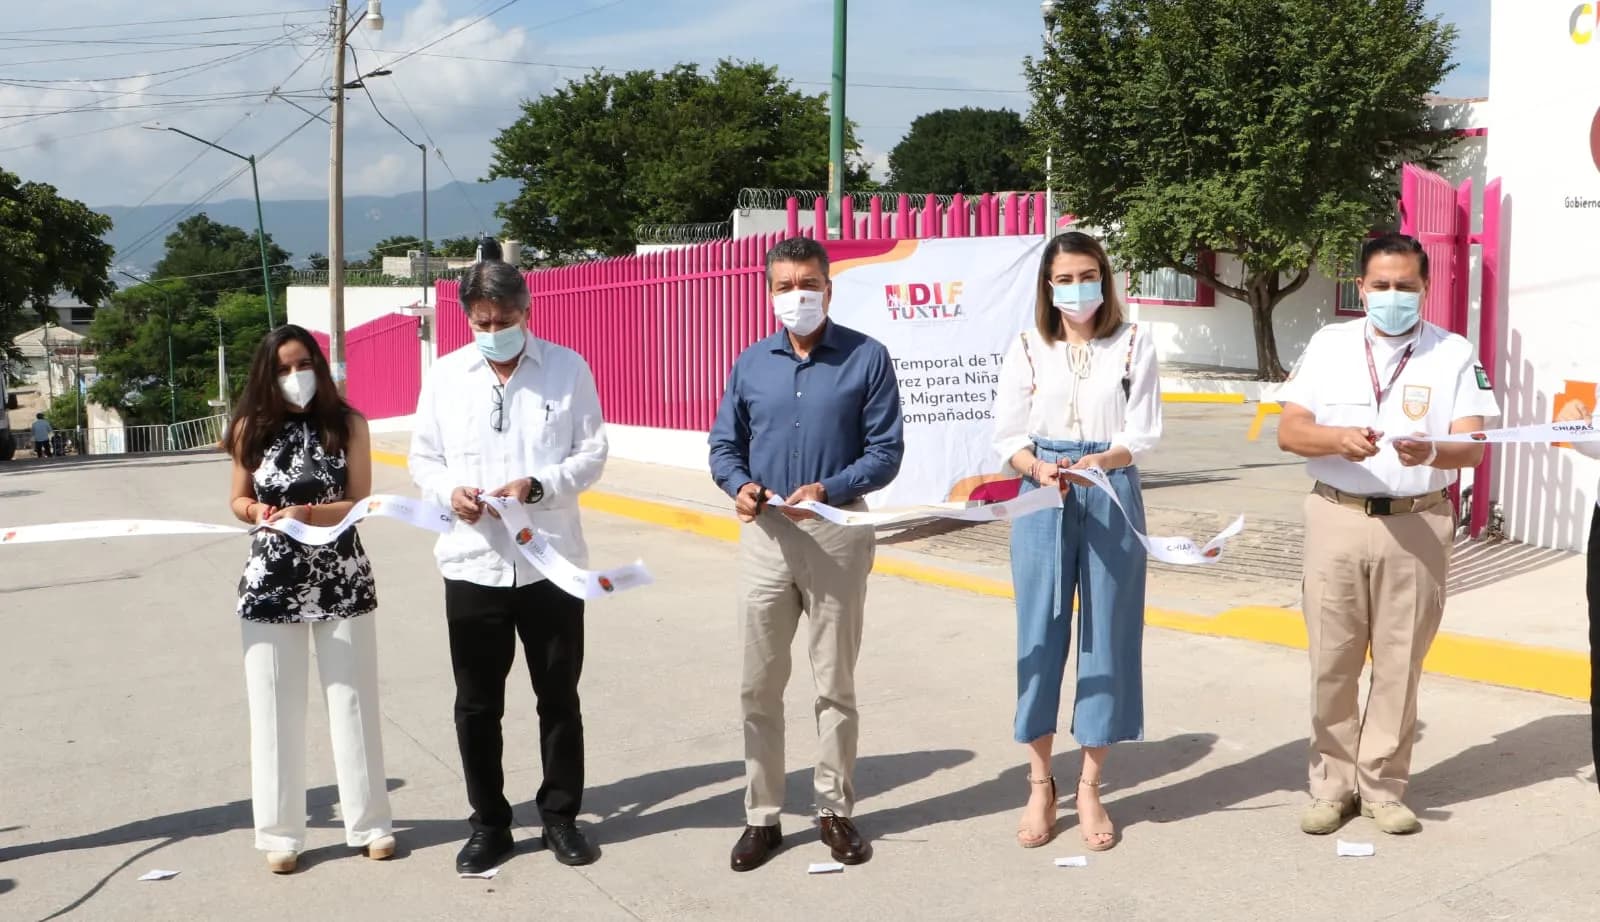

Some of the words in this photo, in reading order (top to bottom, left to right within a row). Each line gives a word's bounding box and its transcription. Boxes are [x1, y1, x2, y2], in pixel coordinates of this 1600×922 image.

[888, 304, 964, 320] TUXTLA
[891, 355, 964, 371] Temporal
[968, 354, 987, 367] de
[926, 375, 960, 389] para
[964, 371, 999, 385] Niña
[910, 391, 987, 407] Migrantes
[903, 408, 995, 424] ompañados.
[1551, 423, 1595, 432] CHIAPAS
